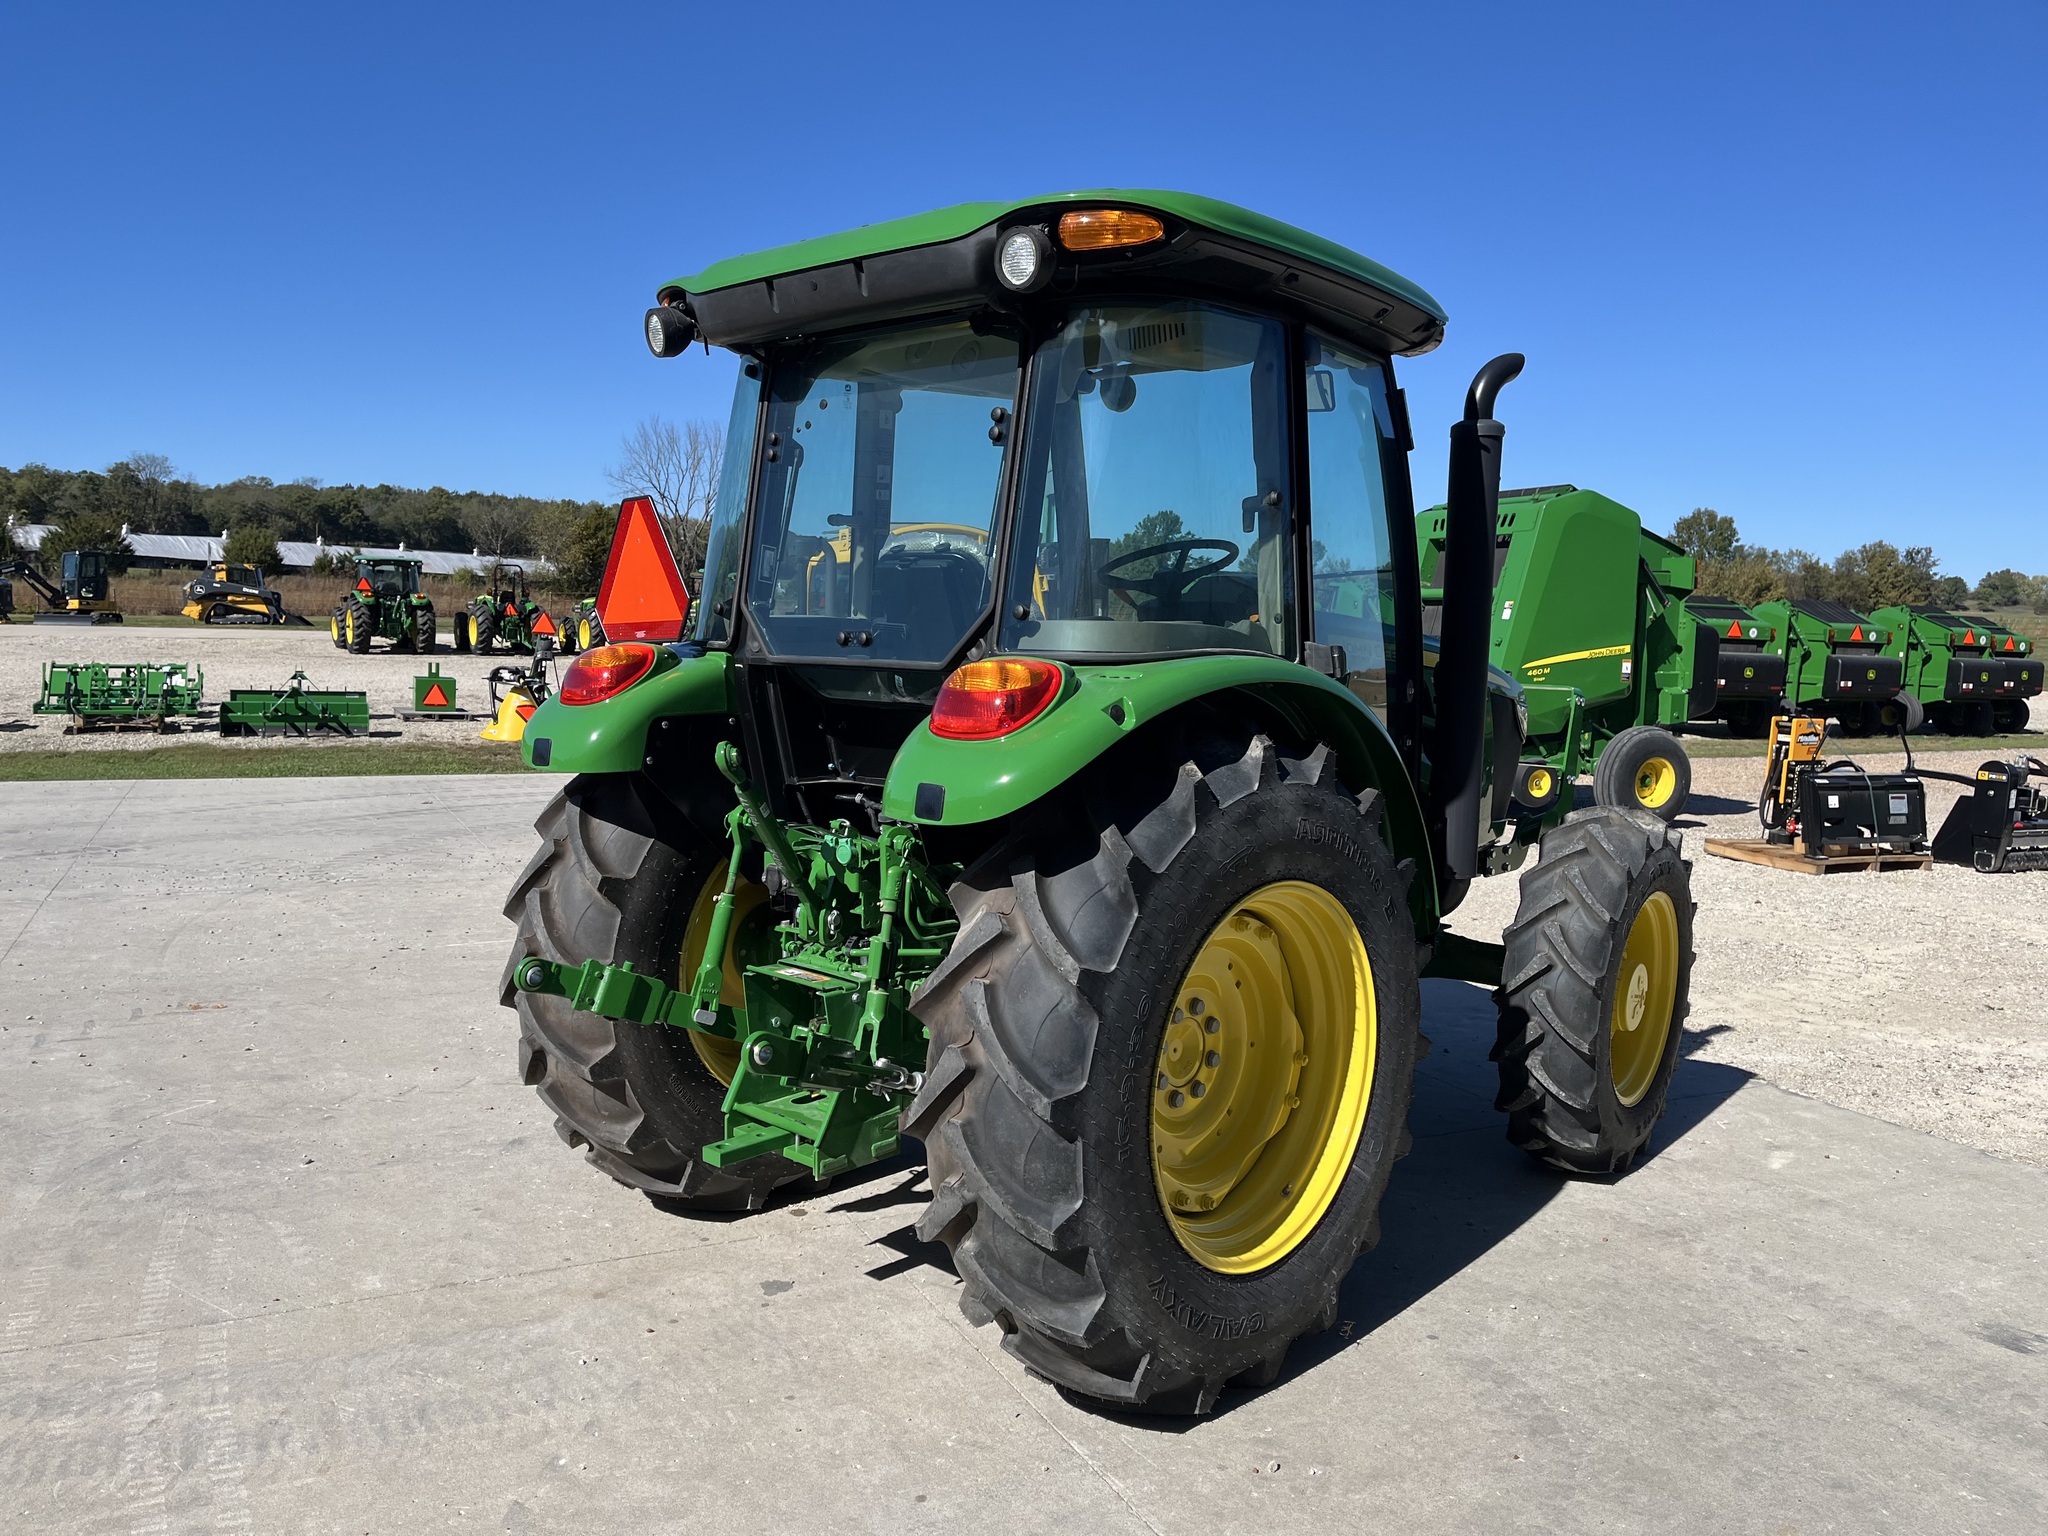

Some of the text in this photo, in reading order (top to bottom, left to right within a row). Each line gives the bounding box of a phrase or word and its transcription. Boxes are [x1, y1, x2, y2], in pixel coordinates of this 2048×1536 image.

[1587, 648, 1626, 659] JOHN DEERE
[1527, 668, 1543, 676] 460
[1147, 1274, 1265, 1340] GALAXY
